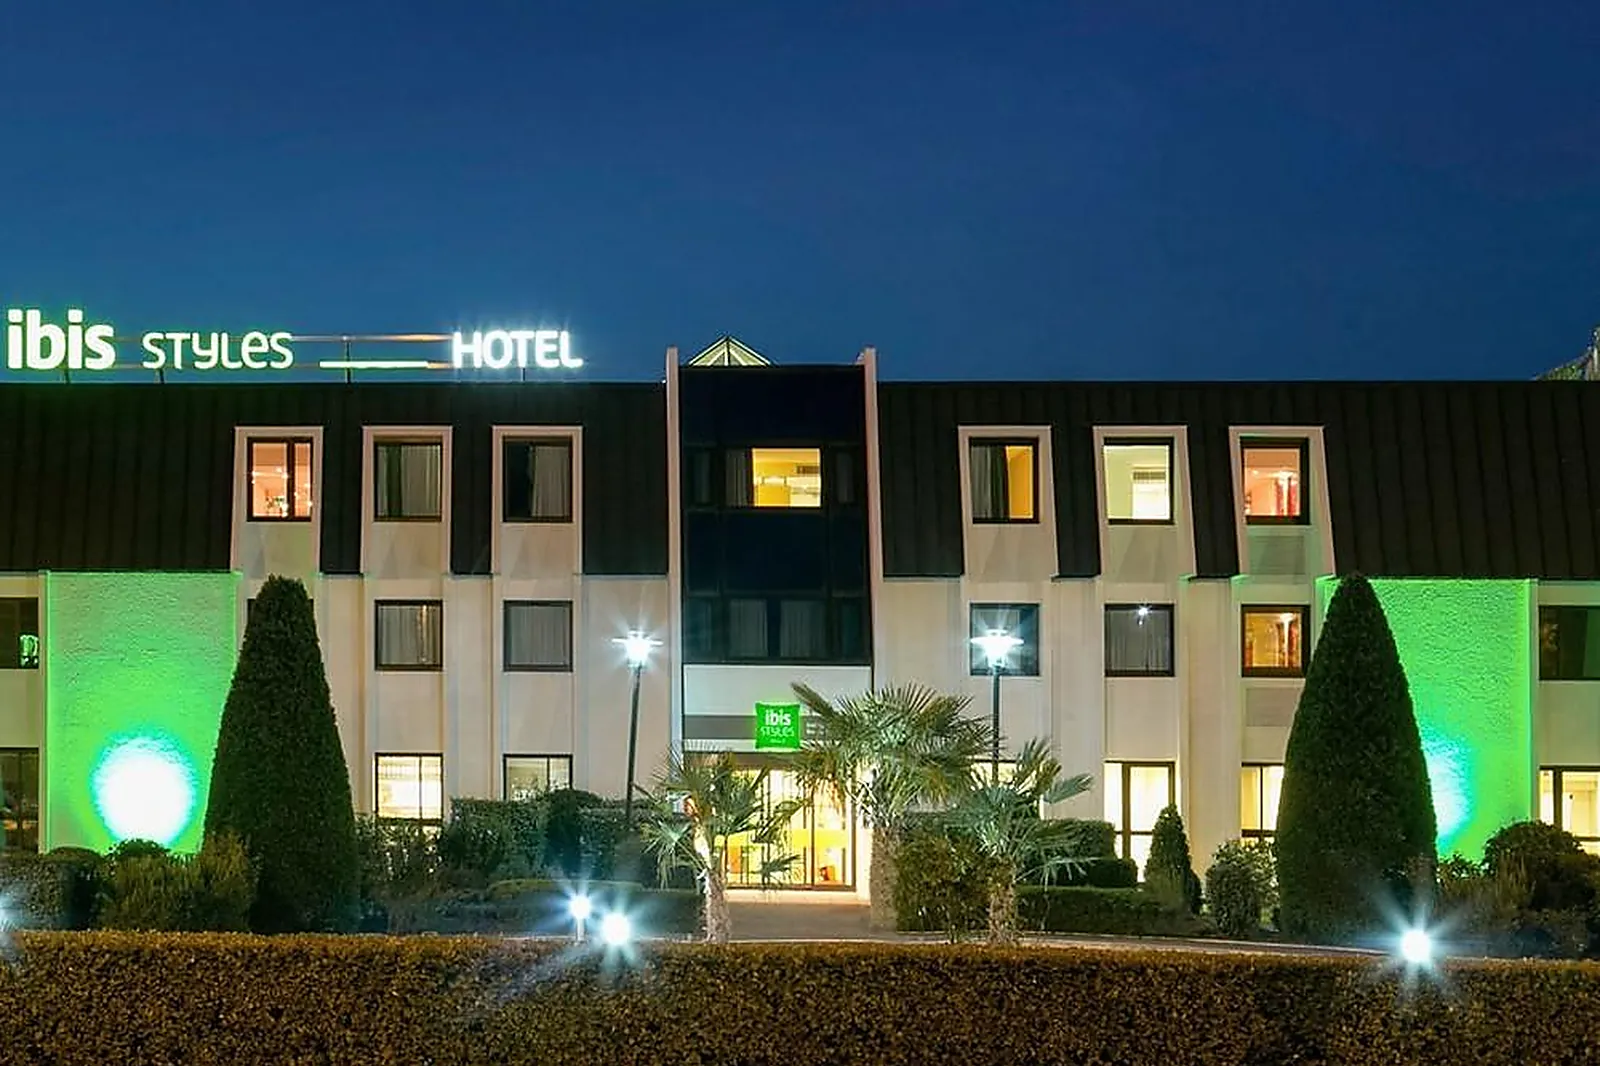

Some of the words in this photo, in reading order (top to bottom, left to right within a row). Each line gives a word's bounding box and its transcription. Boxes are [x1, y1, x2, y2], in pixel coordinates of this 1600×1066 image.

[7, 308, 116, 370] ibis
[452, 329, 584, 369] HOTEL
[764, 709, 792, 726] ibis
